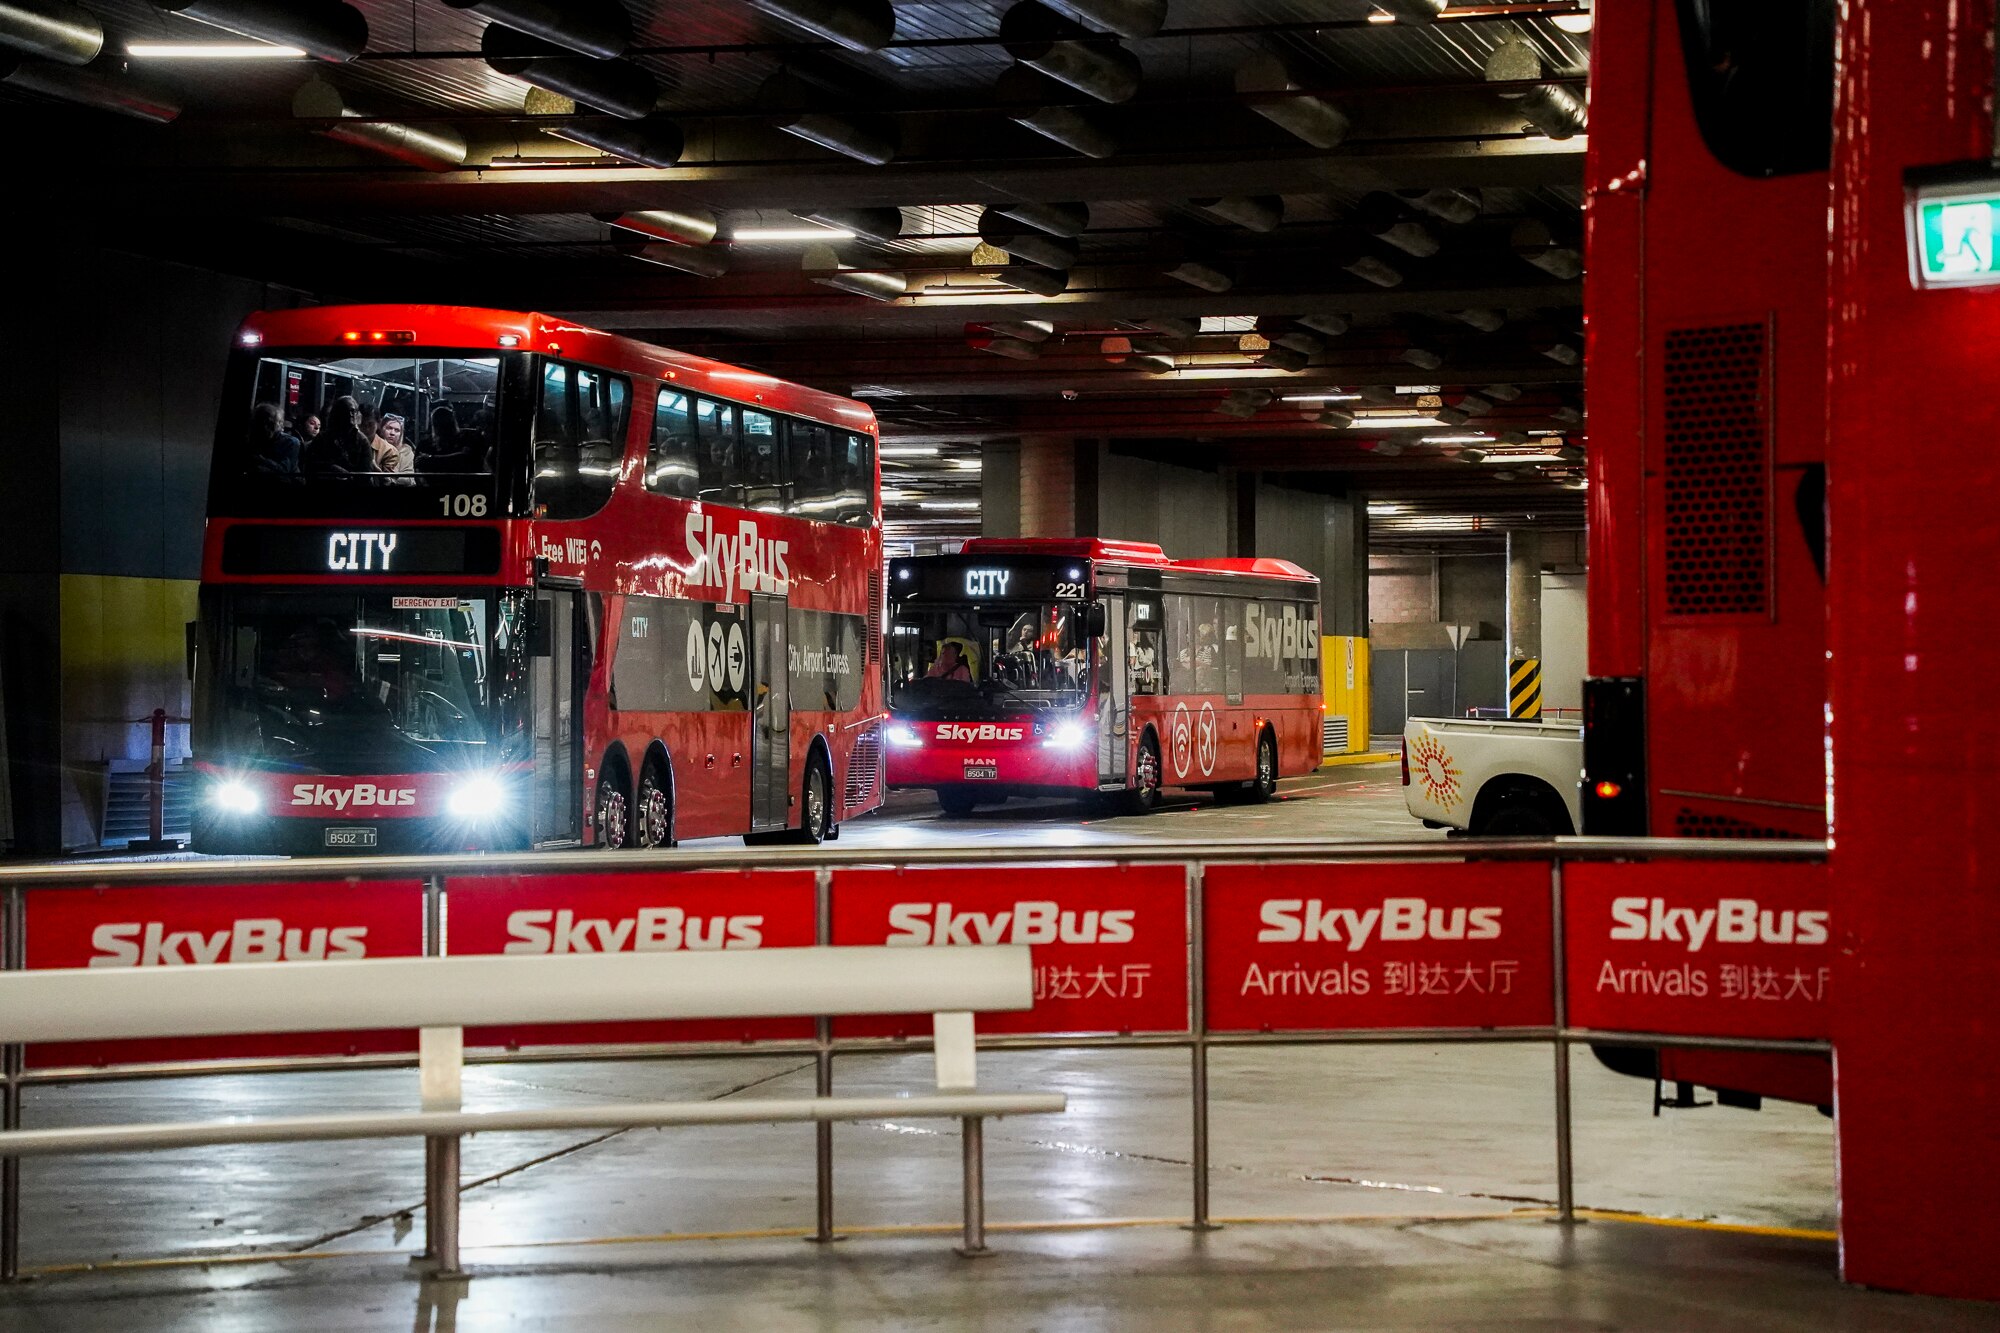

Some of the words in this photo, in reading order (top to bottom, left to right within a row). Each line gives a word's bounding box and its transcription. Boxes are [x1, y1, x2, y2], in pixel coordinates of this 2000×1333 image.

[439, 494, 487, 517] 108
[329, 533, 397, 570] CITY
[542, 535, 564, 563] Free
[685, 512, 789, 603] SkyBus
[966, 570, 1009, 595] CITY
[1055, 583, 1085, 597] 221
[394, 599, 437, 607] EMERGENCY
[441, 599, 456, 607] EXIT
[632, 616, 648, 638] CITY
[1245, 603, 1319, 671] SkyBus
[936, 724, 1023, 743] SkyBus
[963, 758, 996, 766] MAN
[291, 784, 417, 810] SkyBus
[504, 907, 764, 954] SkyBus
[886, 901, 1136, 946] SkyBus
[1258, 898, 1502, 951] SkyBus
[1610, 897, 1829, 952] SkyBus
[88, 918, 368, 968] SkyBus
[1241, 961, 1371, 996] Arrivals
[1384, 960, 1519, 995] 到达大厅
[1597, 960, 1709, 996] Arrivals
